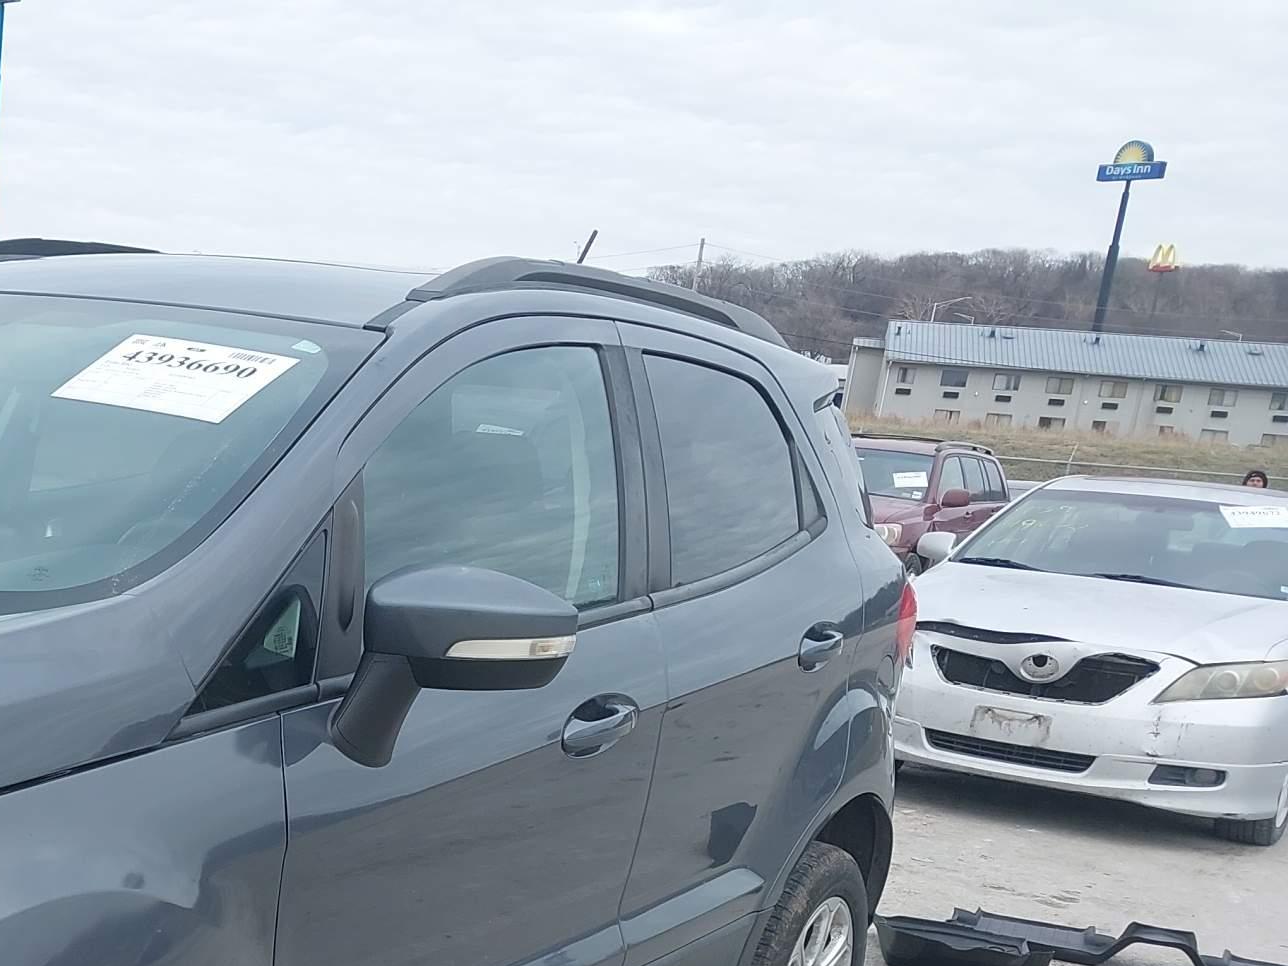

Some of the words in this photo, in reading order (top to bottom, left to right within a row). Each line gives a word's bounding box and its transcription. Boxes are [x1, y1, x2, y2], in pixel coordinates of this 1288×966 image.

[1105, 165, 1132, 176] Days
[1132, 164, 1152, 174] Inn
[122, 349, 258, 379] 43936690
